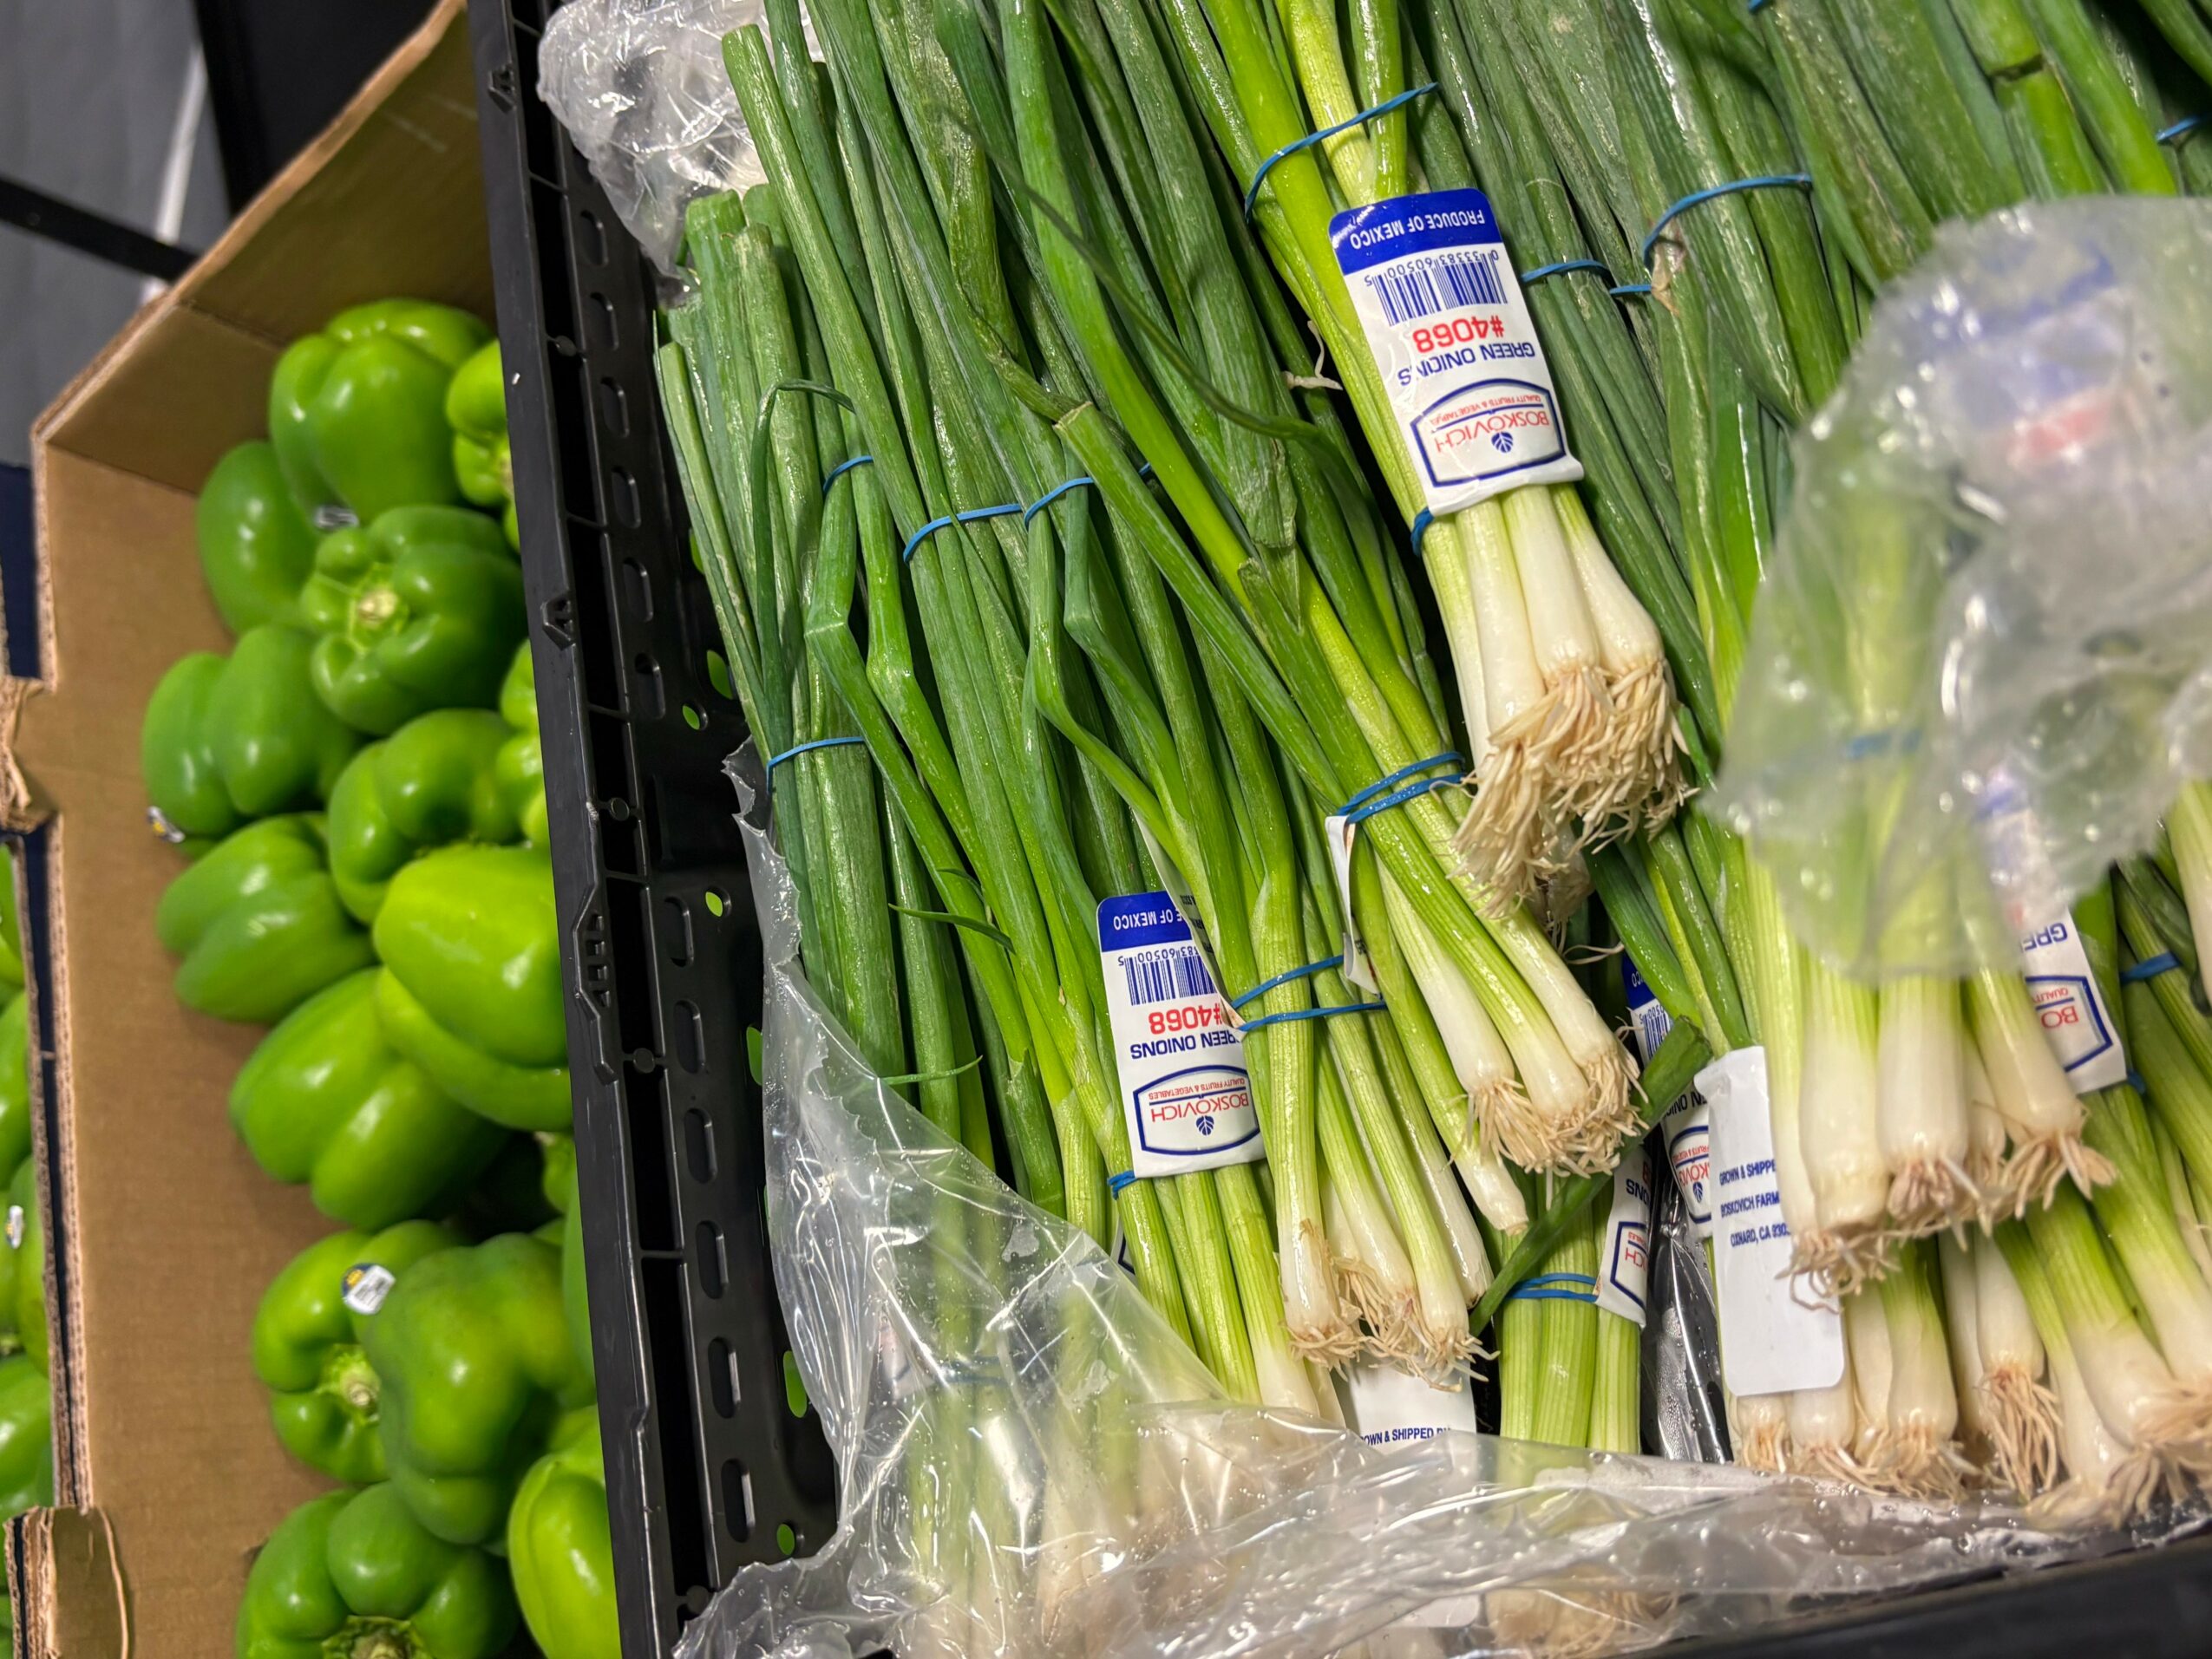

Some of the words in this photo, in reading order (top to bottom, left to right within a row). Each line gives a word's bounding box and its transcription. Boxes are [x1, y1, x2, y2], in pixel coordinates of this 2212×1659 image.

[1407, 216, 1425, 232] OF
[1426, 209, 1485, 229] PRODUCE
[1350, 219, 1404, 250] MEXICO
[1390, 256, 1433, 279] 60500
[1439, 251, 1479, 265] 33383
[1412, 316, 1504, 353] #4068
[1476, 342, 1535, 360] GREEN
[1397, 348, 1476, 386] ONIONS
[1482, 401, 1488, 409] &
[1489, 396, 1516, 408] FRUITS
[1517, 395, 1541, 406] QUALITY
[1434, 410, 1549, 453] BOSKOVICH
[1113, 911, 1157, 931] MEXICO
[1161, 909, 1174, 924] OF
[1138, 948, 1175, 963] 60500
[2032, 988, 2069, 1003] QUALIT
[1148, 1003, 1222, 1035] #4068
[1130, 1035, 1196, 1060] ONIONS
[1201, 1029, 1241, 1048] REEN
[1201, 1081, 1224, 1092] FRUITS
[1224, 1077, 1246, 1088] QUALITY
[1149, 1087, 1194, 1101] VEGETABLES
[1150, 1092, 1249, 1122] BOSKOVICH
[1719, 1166, 1739, 1186] GROWN
[1740, 1166, 1746, 1179] &
[1746, 1159, 1776, 1178] SHIPPE
[1720, 1196, 1755, 1218] BOSKOVICH
[1755, 1191, 1780, 1208] FARM
[1759, 1225, 1771, 1240] CA
[1361, 1433, 1383, 1447] OWN
[1384, 1430, 1391, 1442] &
[1391, 1427, 1434, 1441] SHIPPED
